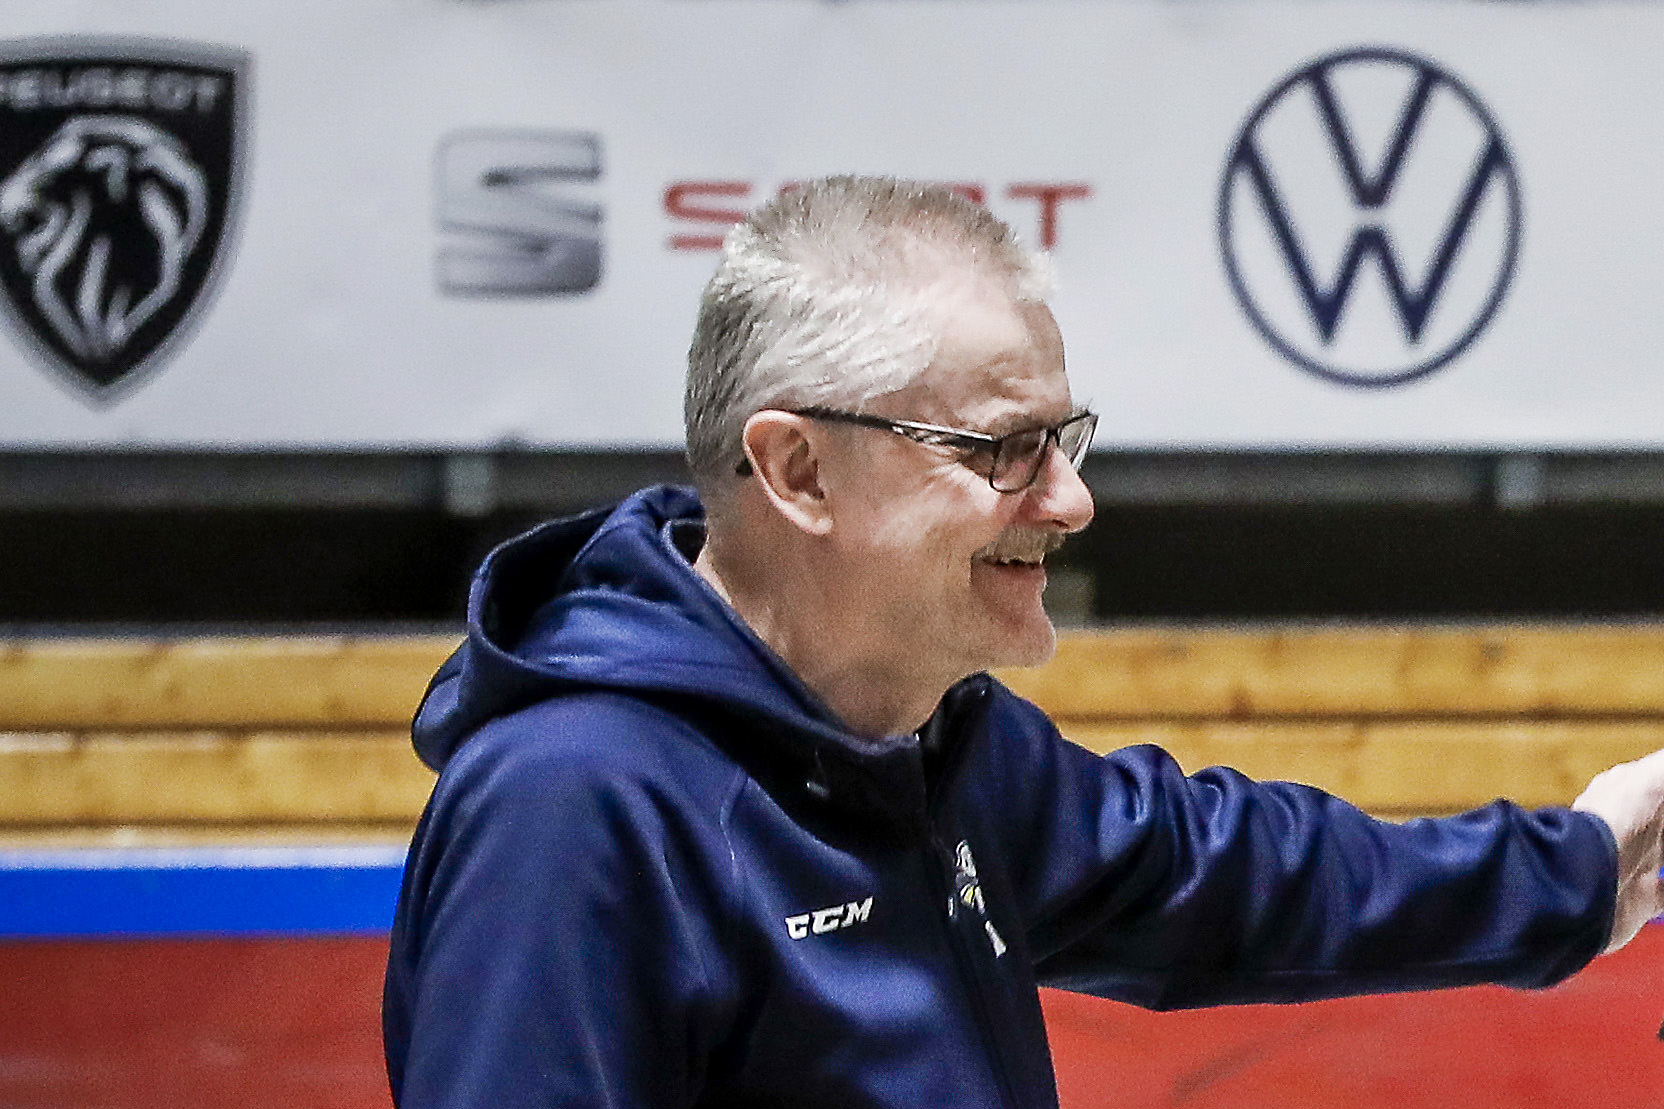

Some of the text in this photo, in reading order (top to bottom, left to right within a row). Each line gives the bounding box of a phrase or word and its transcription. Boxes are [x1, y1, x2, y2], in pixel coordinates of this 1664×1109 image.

[0, 66, 222, 112] EUGEOT
[662, 180, 1093, 254] ST
[785, 896, 873, 940] CCM
